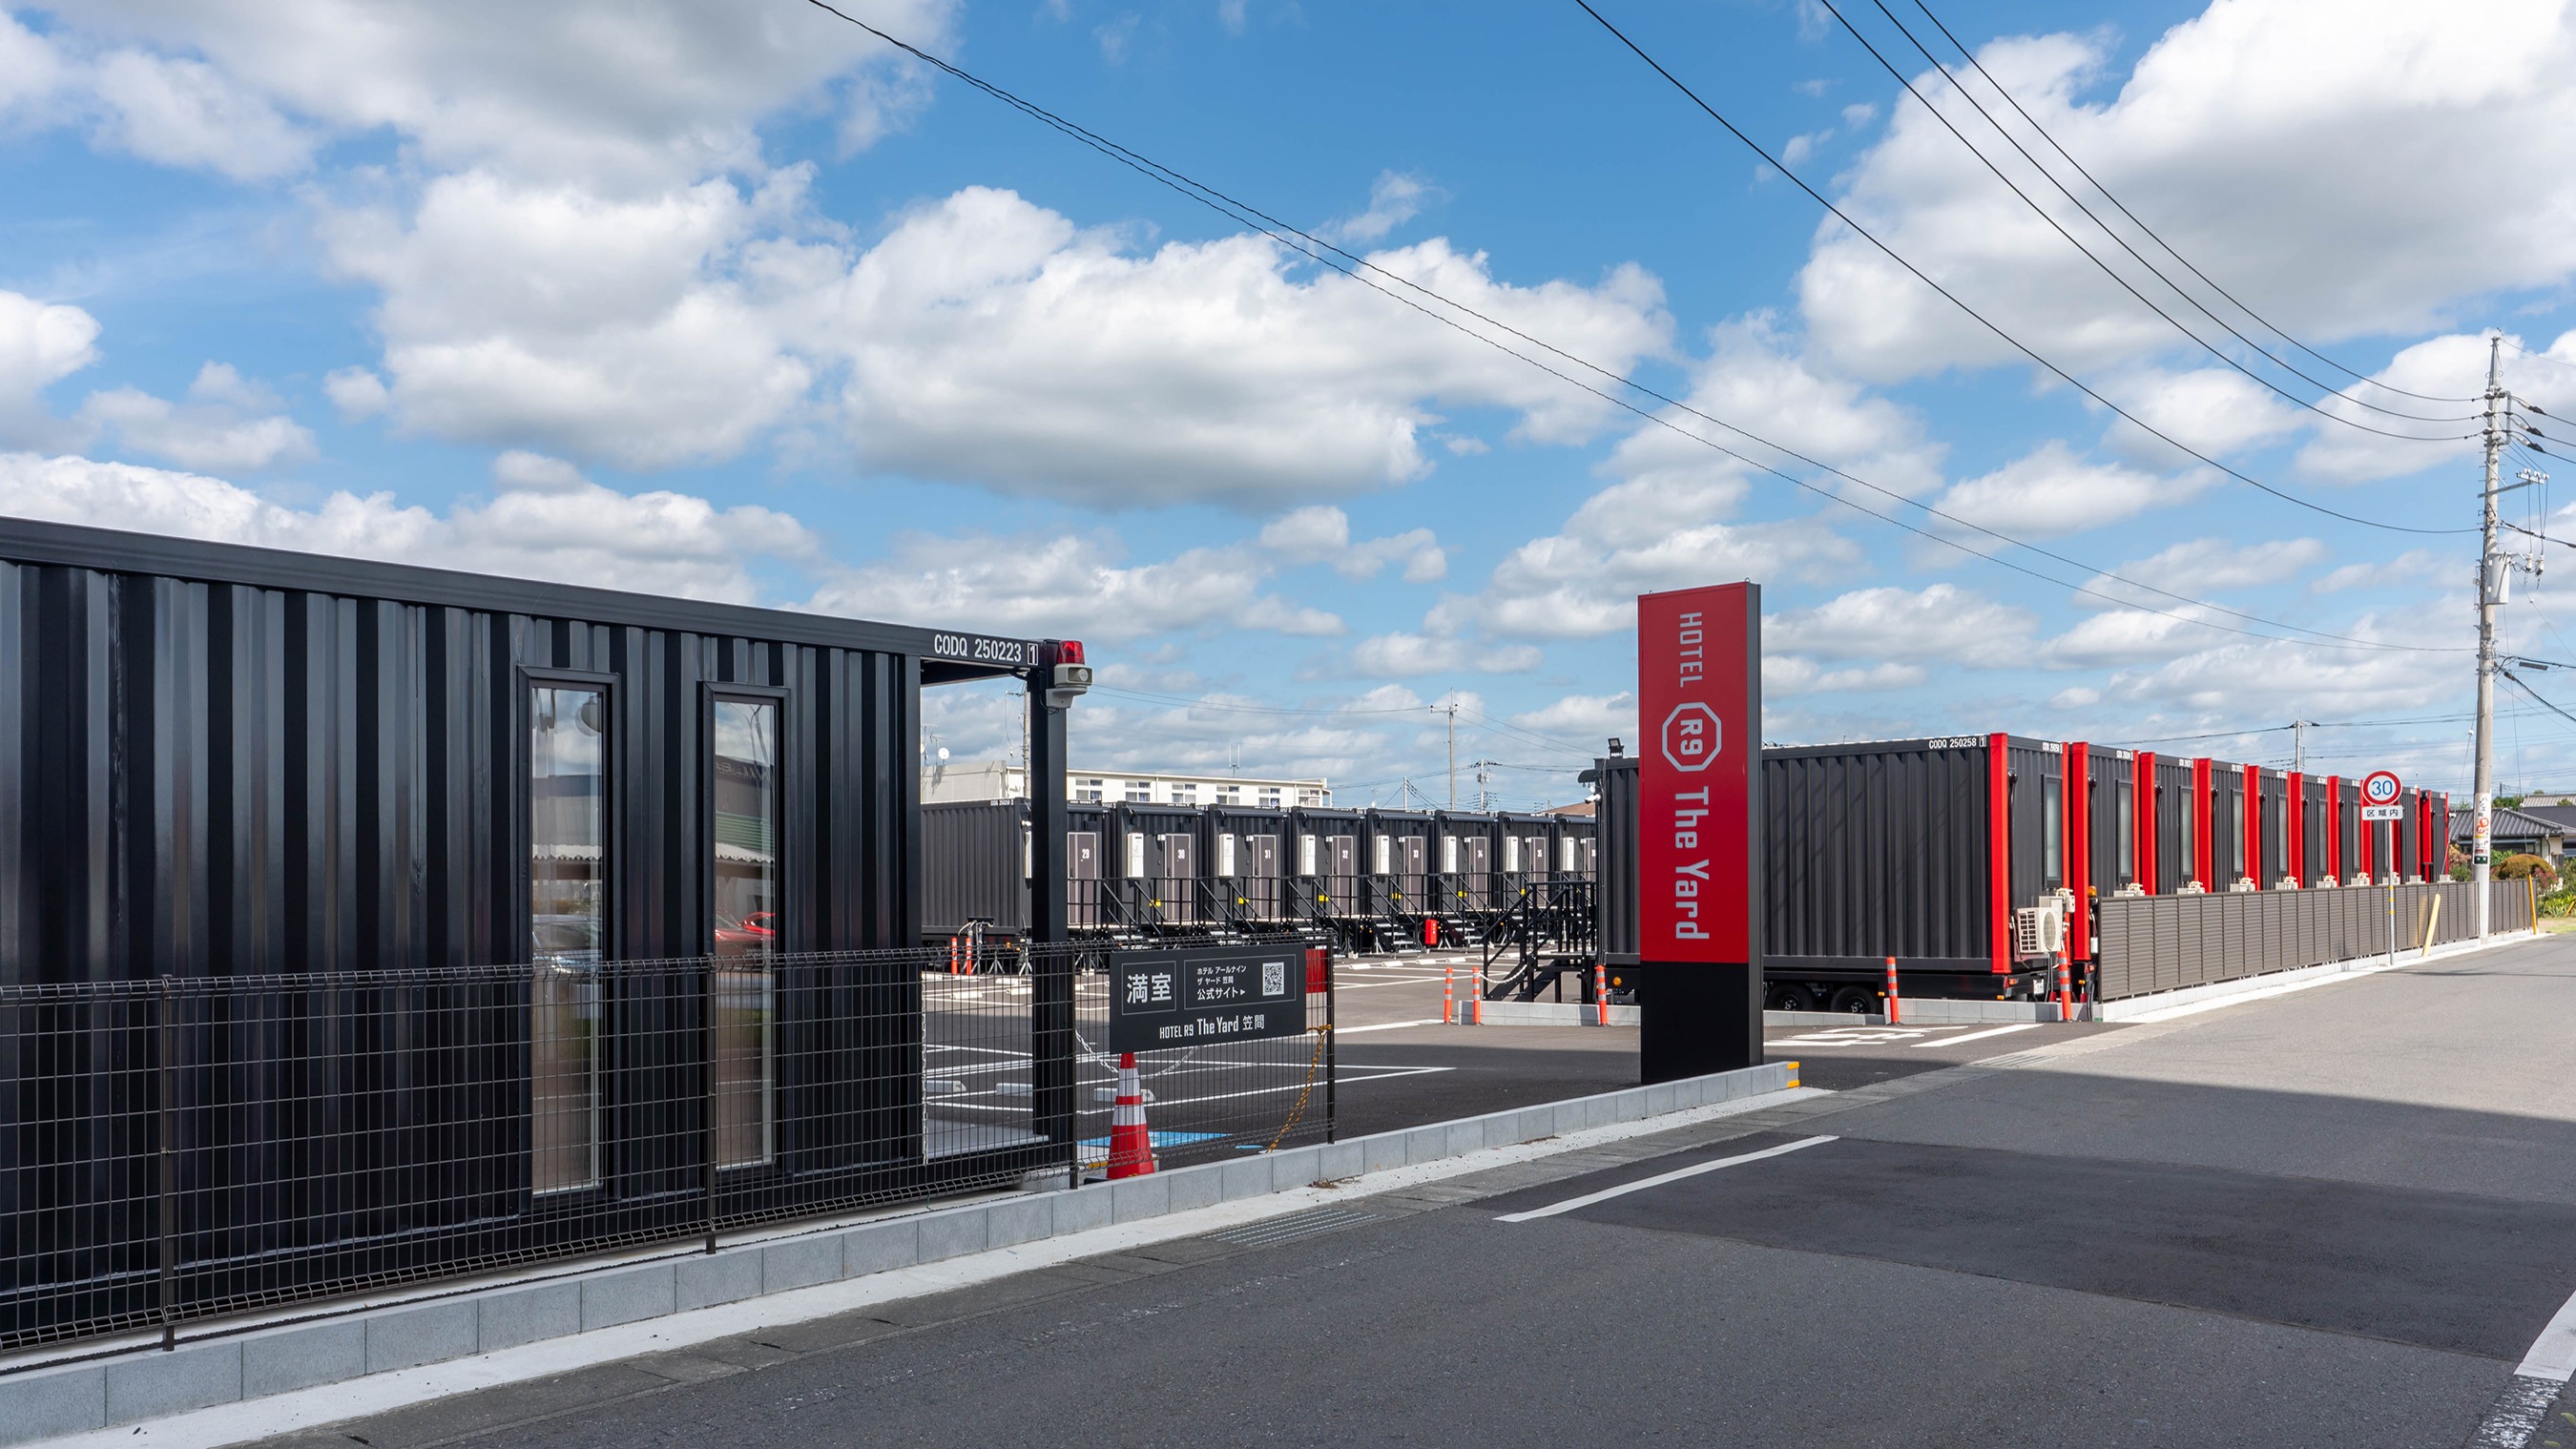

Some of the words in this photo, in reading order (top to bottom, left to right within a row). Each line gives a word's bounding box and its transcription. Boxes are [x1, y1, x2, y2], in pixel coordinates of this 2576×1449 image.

[934, 633, 967, 657] CODQ
[974, 638, 1022, 662] 250223
[1028, 644, 1037, 665] 1
[1679, 611, 1703, 688] HOTEL
[1680, 718, 1703, 756] R9
[1928, 739, 1947, 749] CODQ
[1949, 737, 1977, 748] 250258
[2372, 780, 2393, 796] 30
[1674, 786, 1710, 849] The
[2367, 809, 2399, 818] 区域内
[1177, 849, 1185, 859] 30
[1675, 859, 1711, 939] Yard
[1215, 965, 1246, 974] アールナイン
[1127, 972, 1172, 1004] 満室
[1197, 986, 1238, 1000] 公式サイト
[1159, 1025, 1182, 1039] HOTEL
[1184, 1024, 1194, 1037] R9
[1197, 1018, 1215, 1035] The
[1216, 1015, 1239, 1034] Yard
[1242, 1014, 1265, 1030] 笠間
